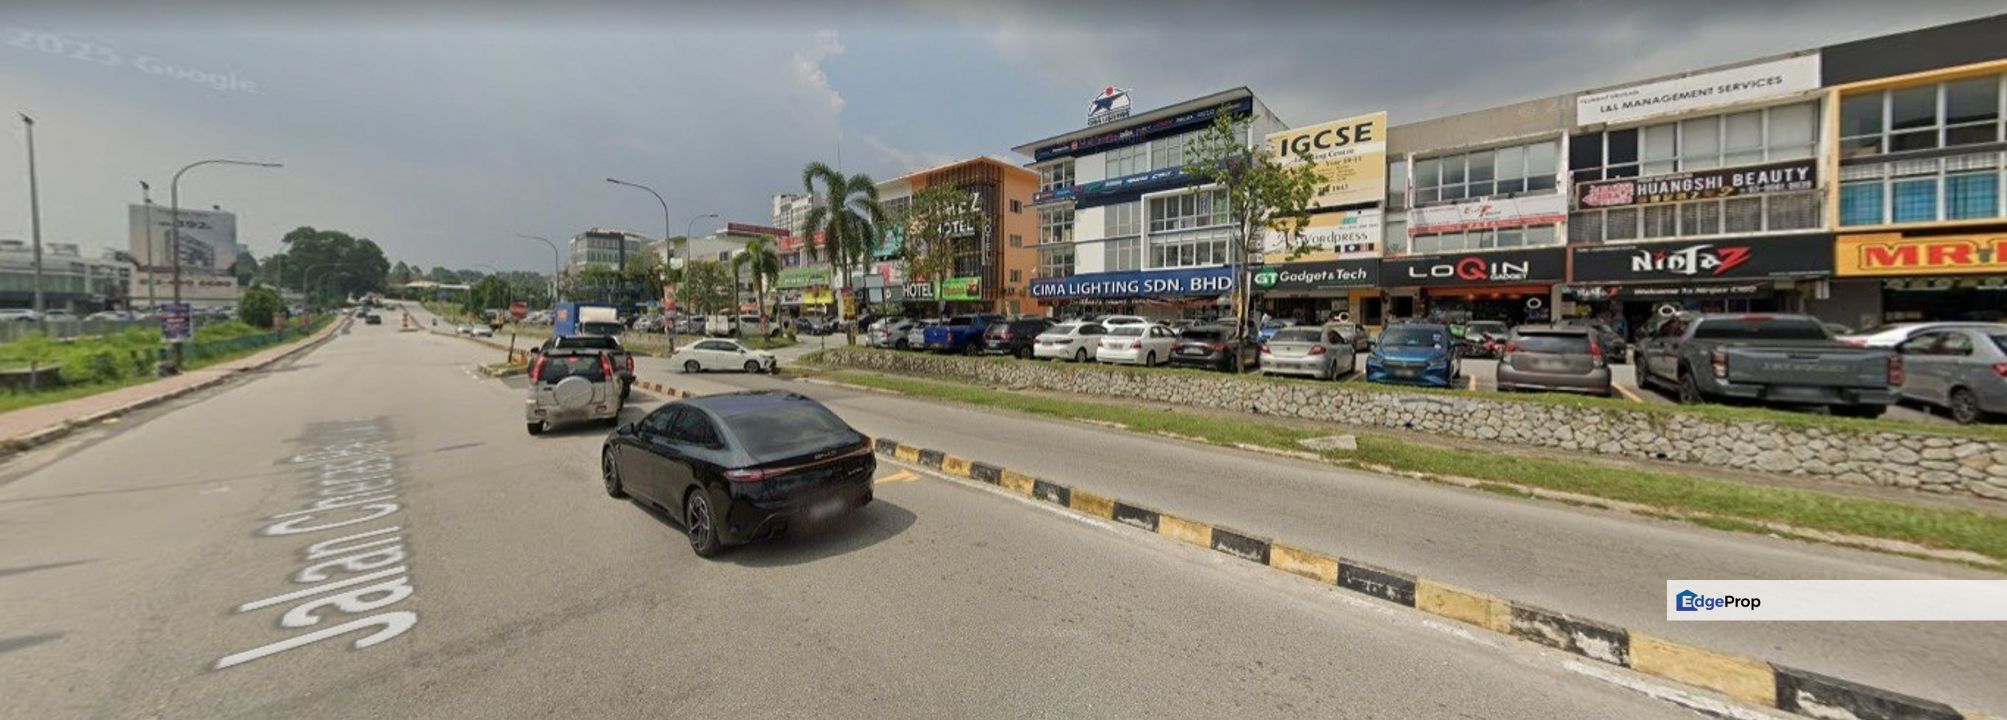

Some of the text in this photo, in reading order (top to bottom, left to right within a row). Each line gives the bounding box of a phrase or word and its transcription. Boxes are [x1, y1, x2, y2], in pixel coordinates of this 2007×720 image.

[1622, 87, 1714, 110] MANAGEMENT
[1717, 75, 1783, 96] SERVICES
[1281, 121, 1373, 157] IGCSE
[1637, 175, 1723, 196] HUANGSHI
[1732, 166, 1811, 187] BEAUTY
[1254, 271, 1278, 285] GT
[1279, 270, 1327, 283] Gadget
[1336, 267, 1367, 280] Tech
[1408, 256, 1530, 281] LOQIN
[1490, 273, 1528, 281] GADGET
[902, 281, 934, 298] HOTEL
[1032, 276, 1233, 297] CIMA LIGHTING SDN. BHD
